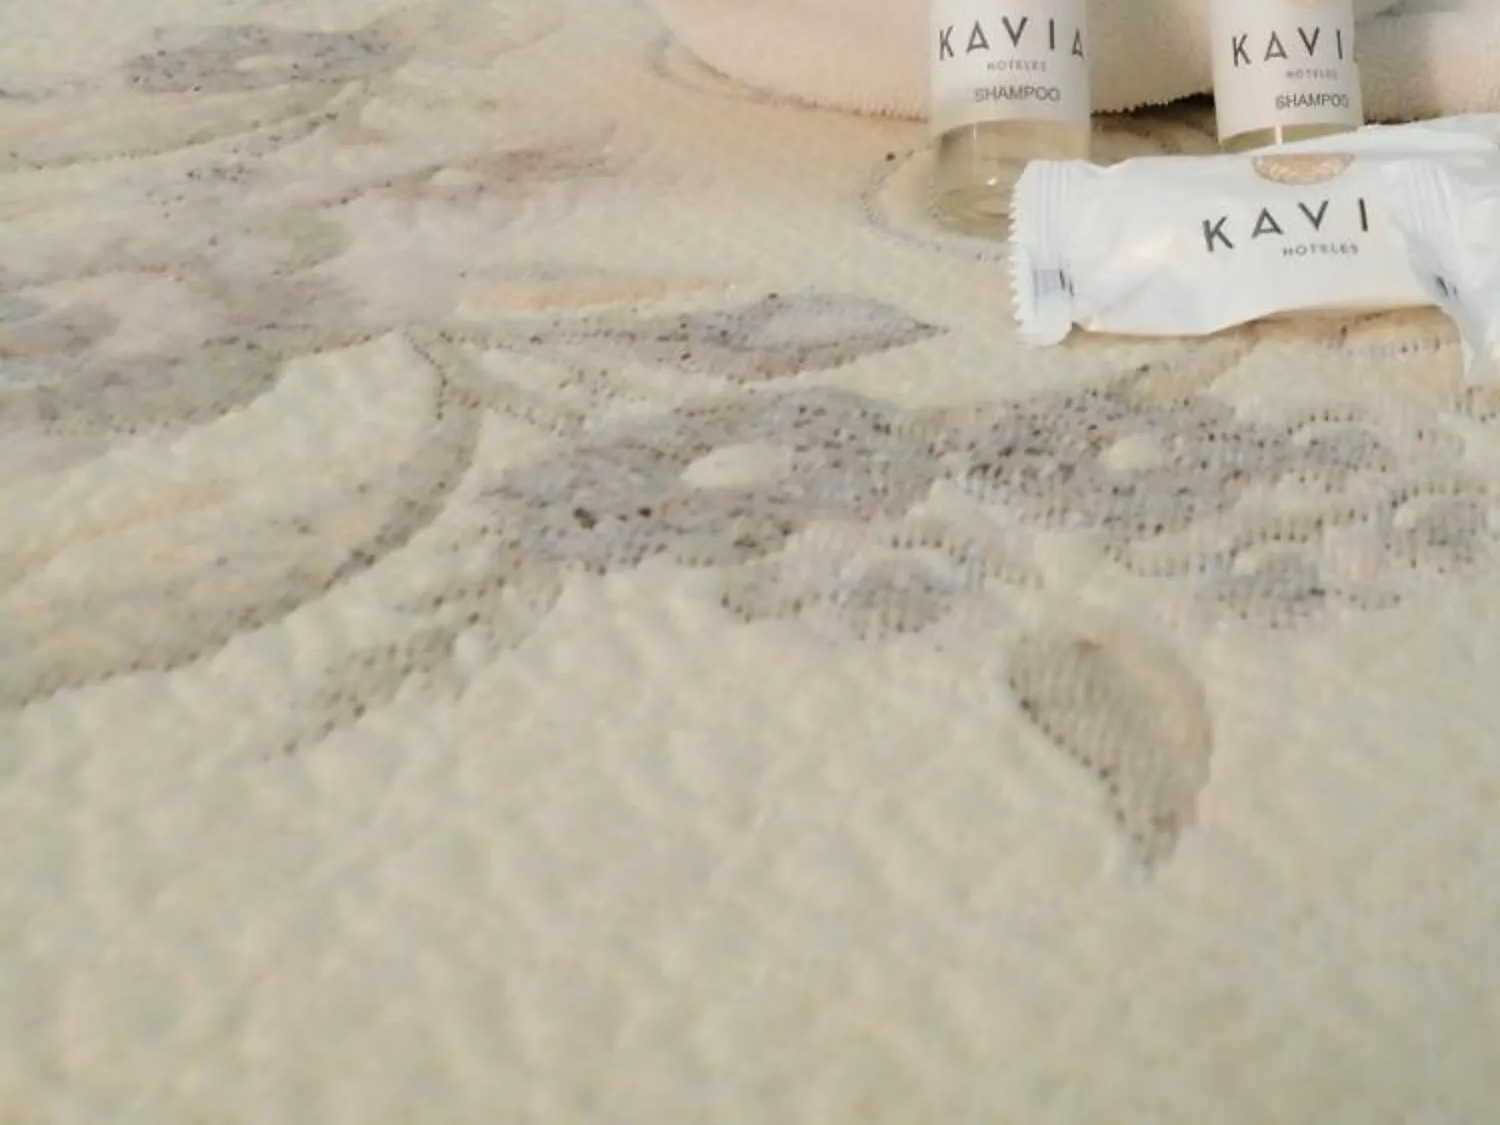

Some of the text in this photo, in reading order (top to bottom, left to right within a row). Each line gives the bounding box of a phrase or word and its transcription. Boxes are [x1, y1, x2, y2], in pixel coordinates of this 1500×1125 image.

[938, 16, 1085, 61] KAVIA
[1232, 27, 1344, 67] KAVI
[975, 85, 1061, 103] SHAMPOO
[1276, 92, 1349, 110] SHAMPOO
[1202, 197, 1369, 253] KAVI
[1282, 242, 1359, 257] HOTELES
